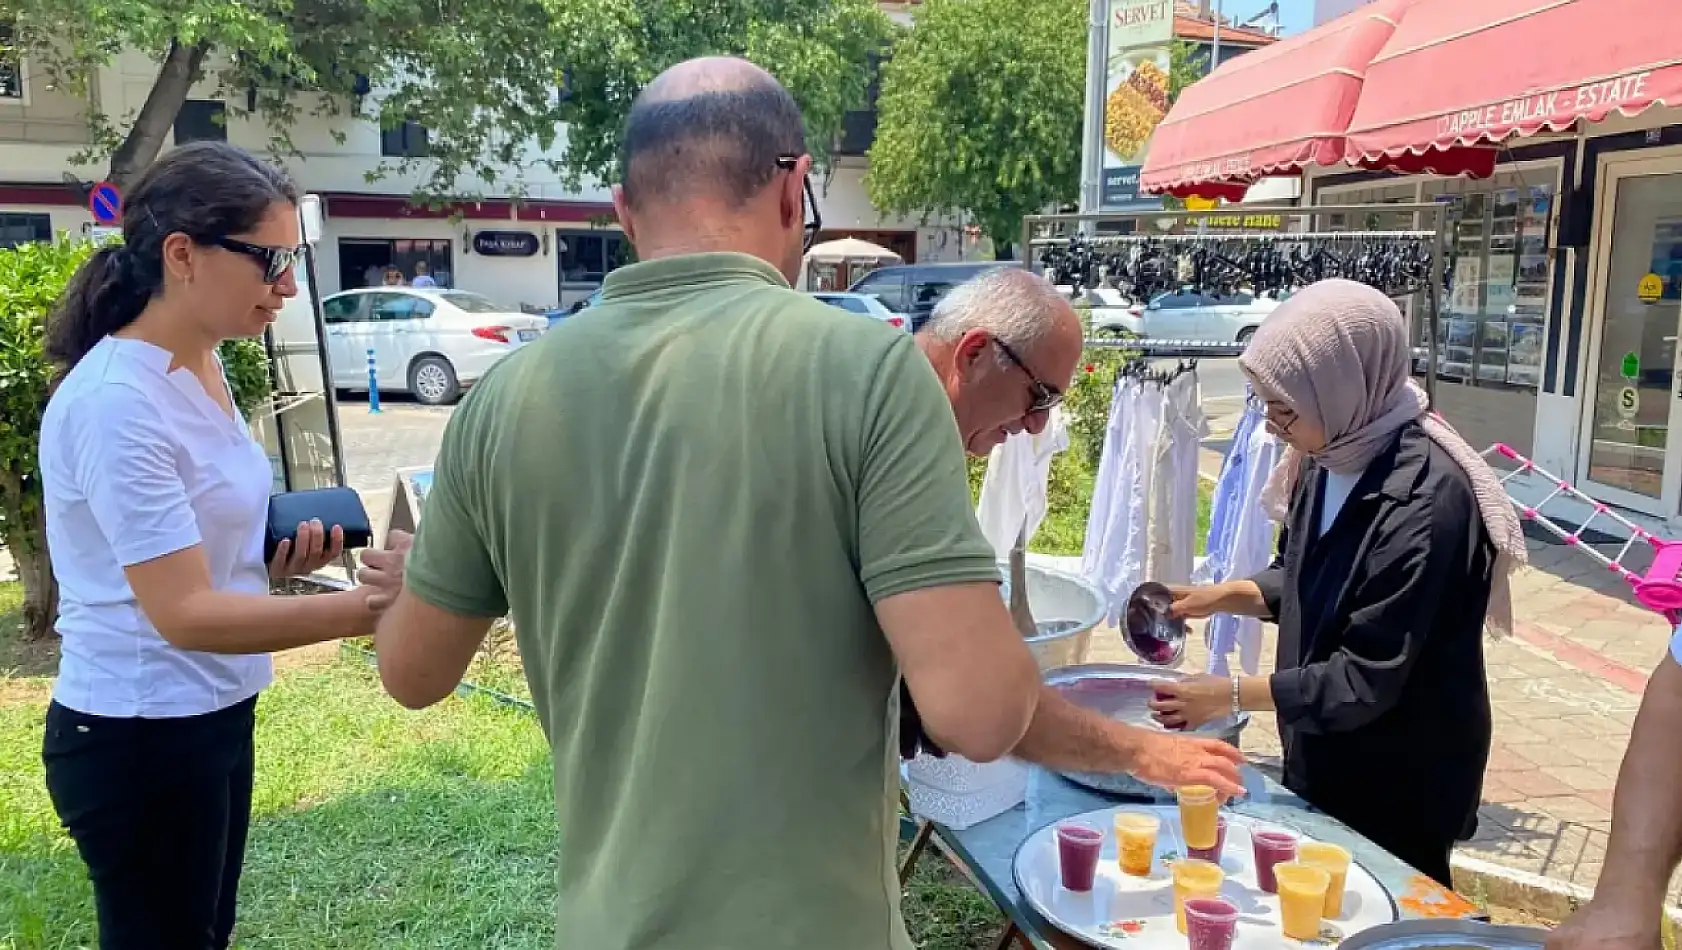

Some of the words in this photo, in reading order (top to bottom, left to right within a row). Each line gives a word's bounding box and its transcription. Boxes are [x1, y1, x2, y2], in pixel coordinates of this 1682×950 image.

[1114, 2, 1167, 28] SERVET
[1450, 105, 1498, 133] APPLE
[1502, 92, 1561, 125] EMLAK
[1575, 72, 1652, 109] ESTATE
